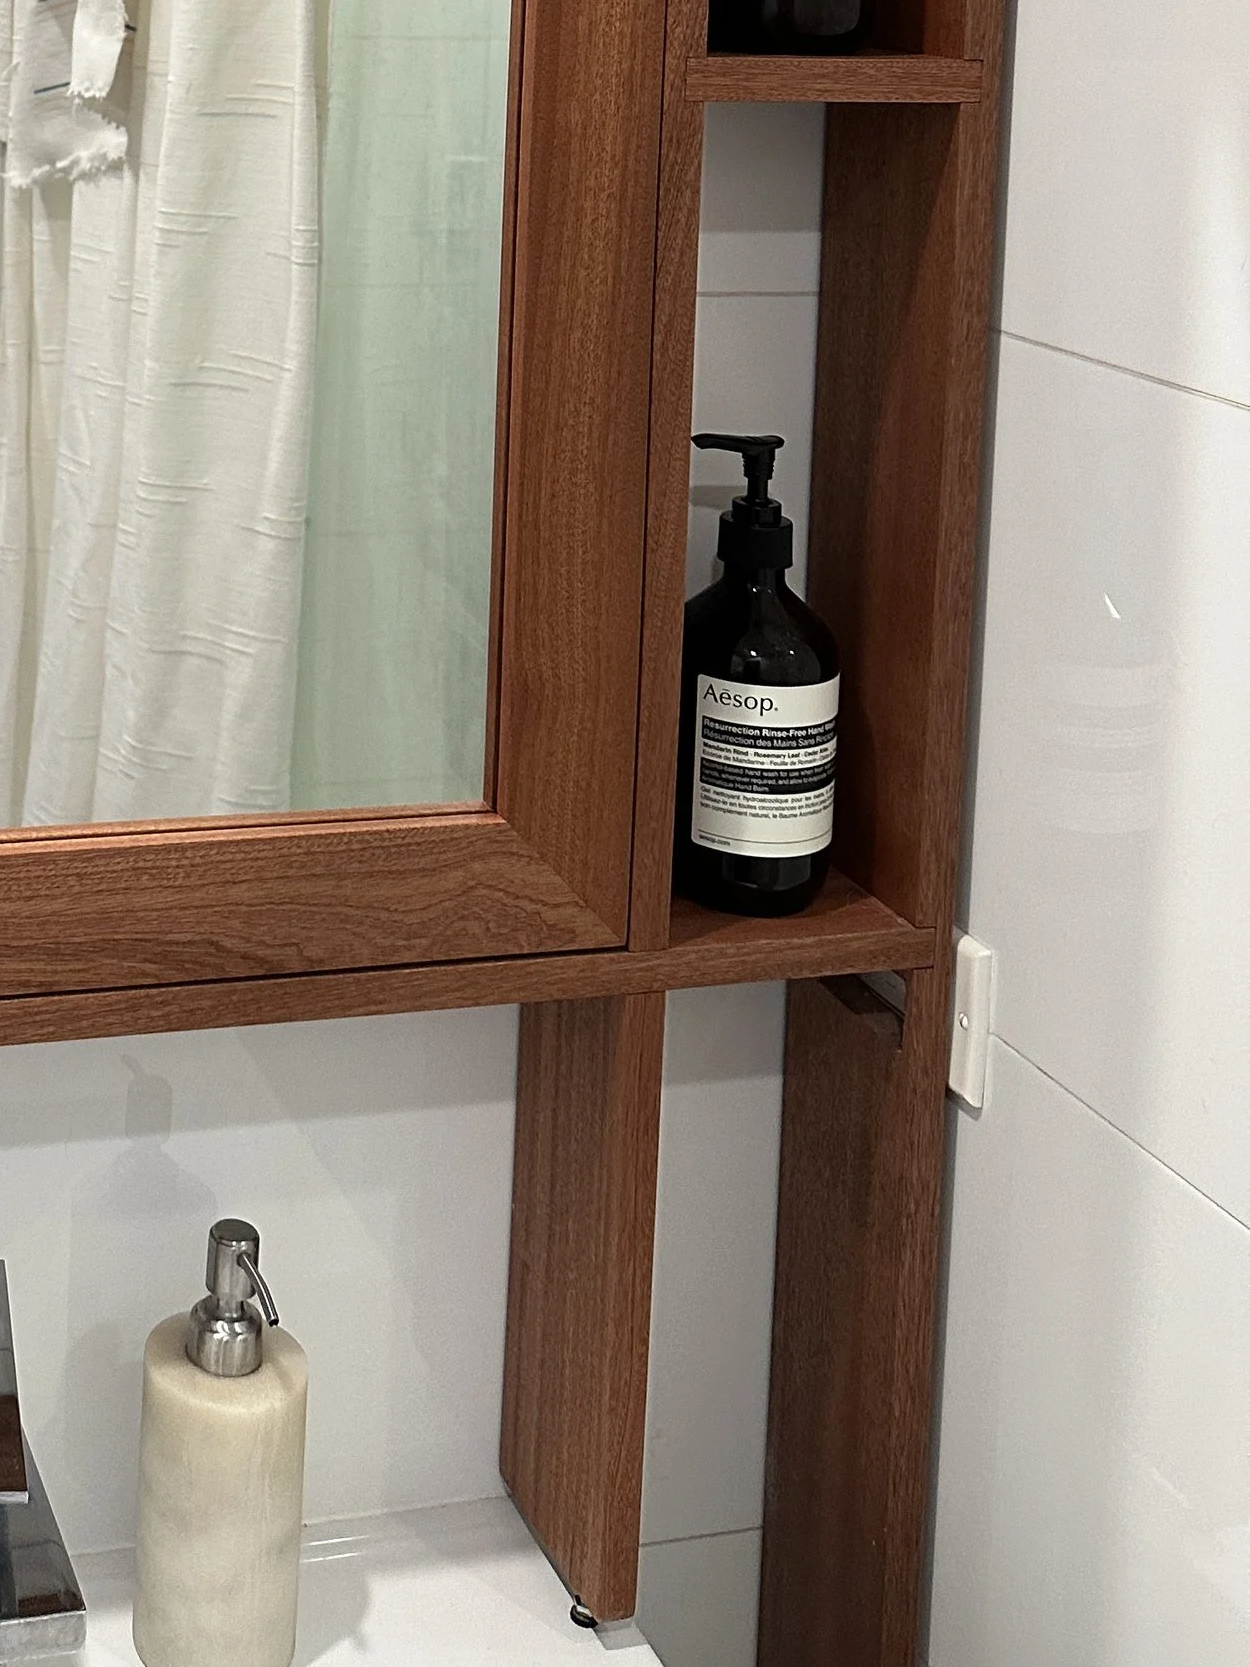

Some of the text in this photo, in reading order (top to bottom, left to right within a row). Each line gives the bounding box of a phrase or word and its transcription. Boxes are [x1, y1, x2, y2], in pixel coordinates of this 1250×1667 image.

[703, 718, 760, 736] Resurrection
[762, 728, 807, 738] Rinse-Free
[703, 728, 754, 746] Résurrection
[756, 738, 771, 747] des
[773, 738, 797, 747] Mains
[798, 736, 815, 746] Sans
